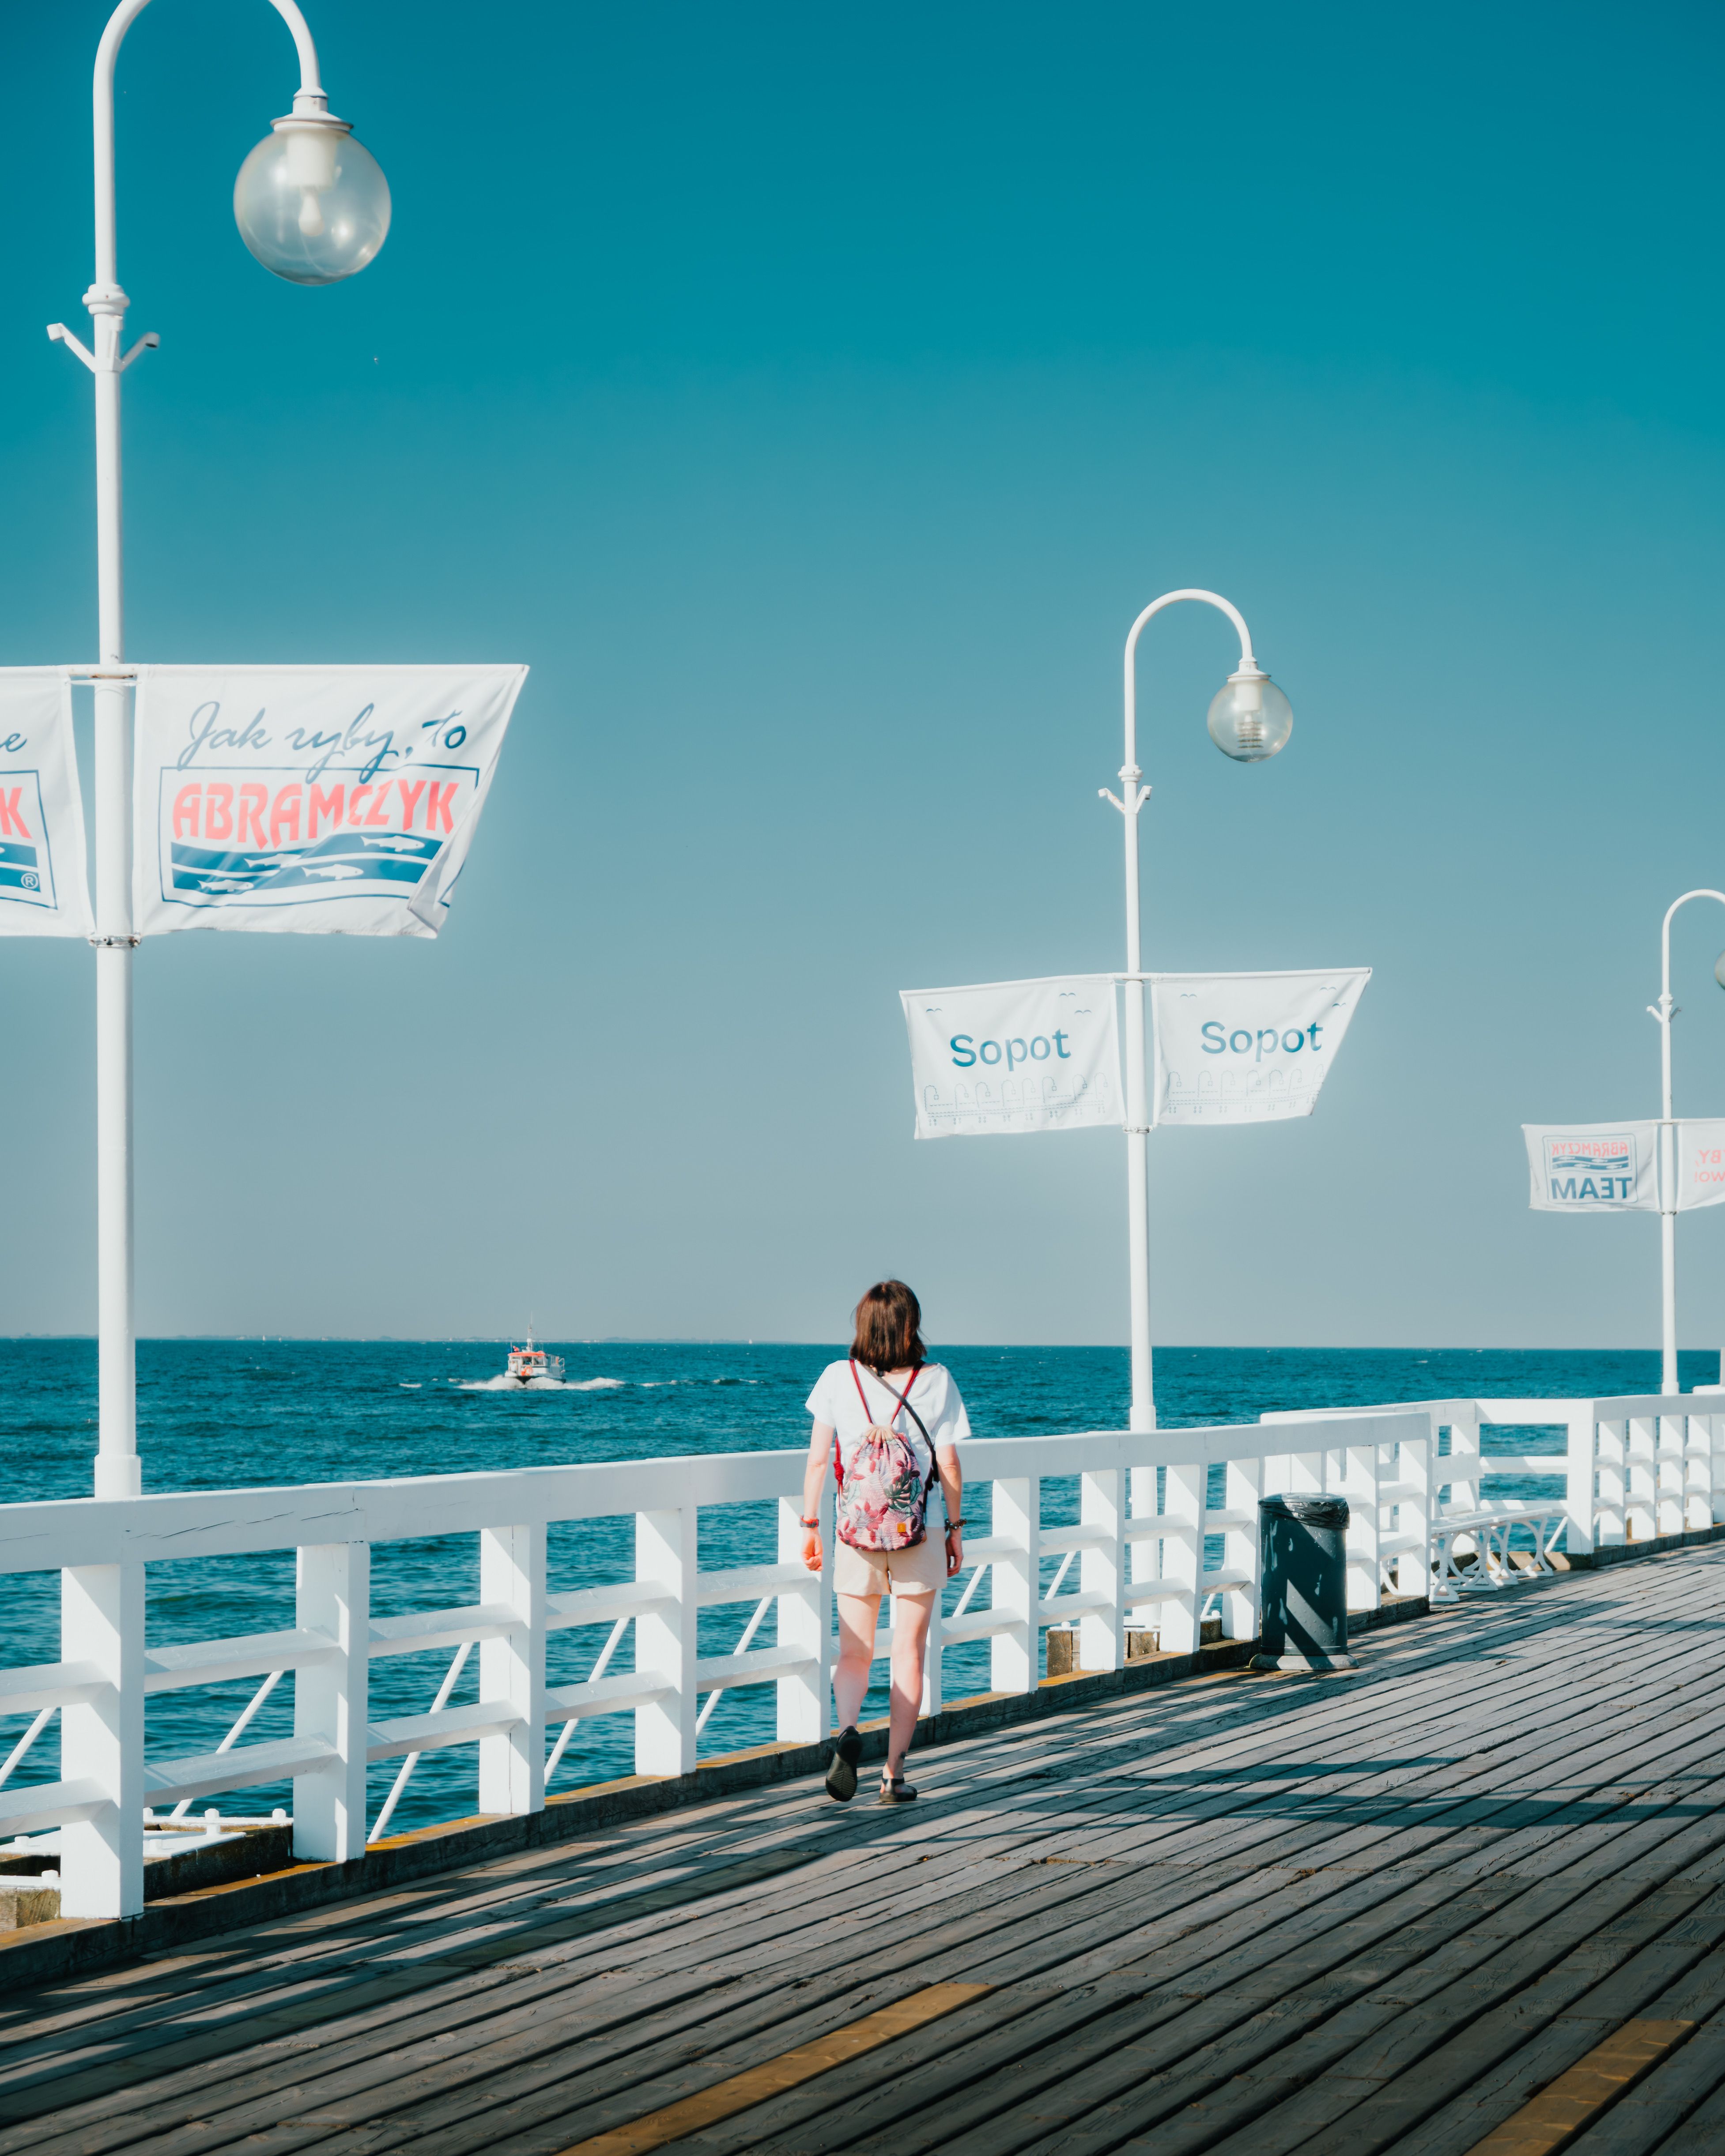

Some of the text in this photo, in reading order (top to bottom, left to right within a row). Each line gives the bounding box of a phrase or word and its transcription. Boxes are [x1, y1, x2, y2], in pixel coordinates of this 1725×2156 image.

[0, 732, 27, 753] e
[177, 701, 467, 784] Jak ryby, to
[173, 779, 460, 851] ABRAMCZYK
[950, 1028, 1072, 1072] Sopot
[1200, 1021, 1324, 1062] Sopot
